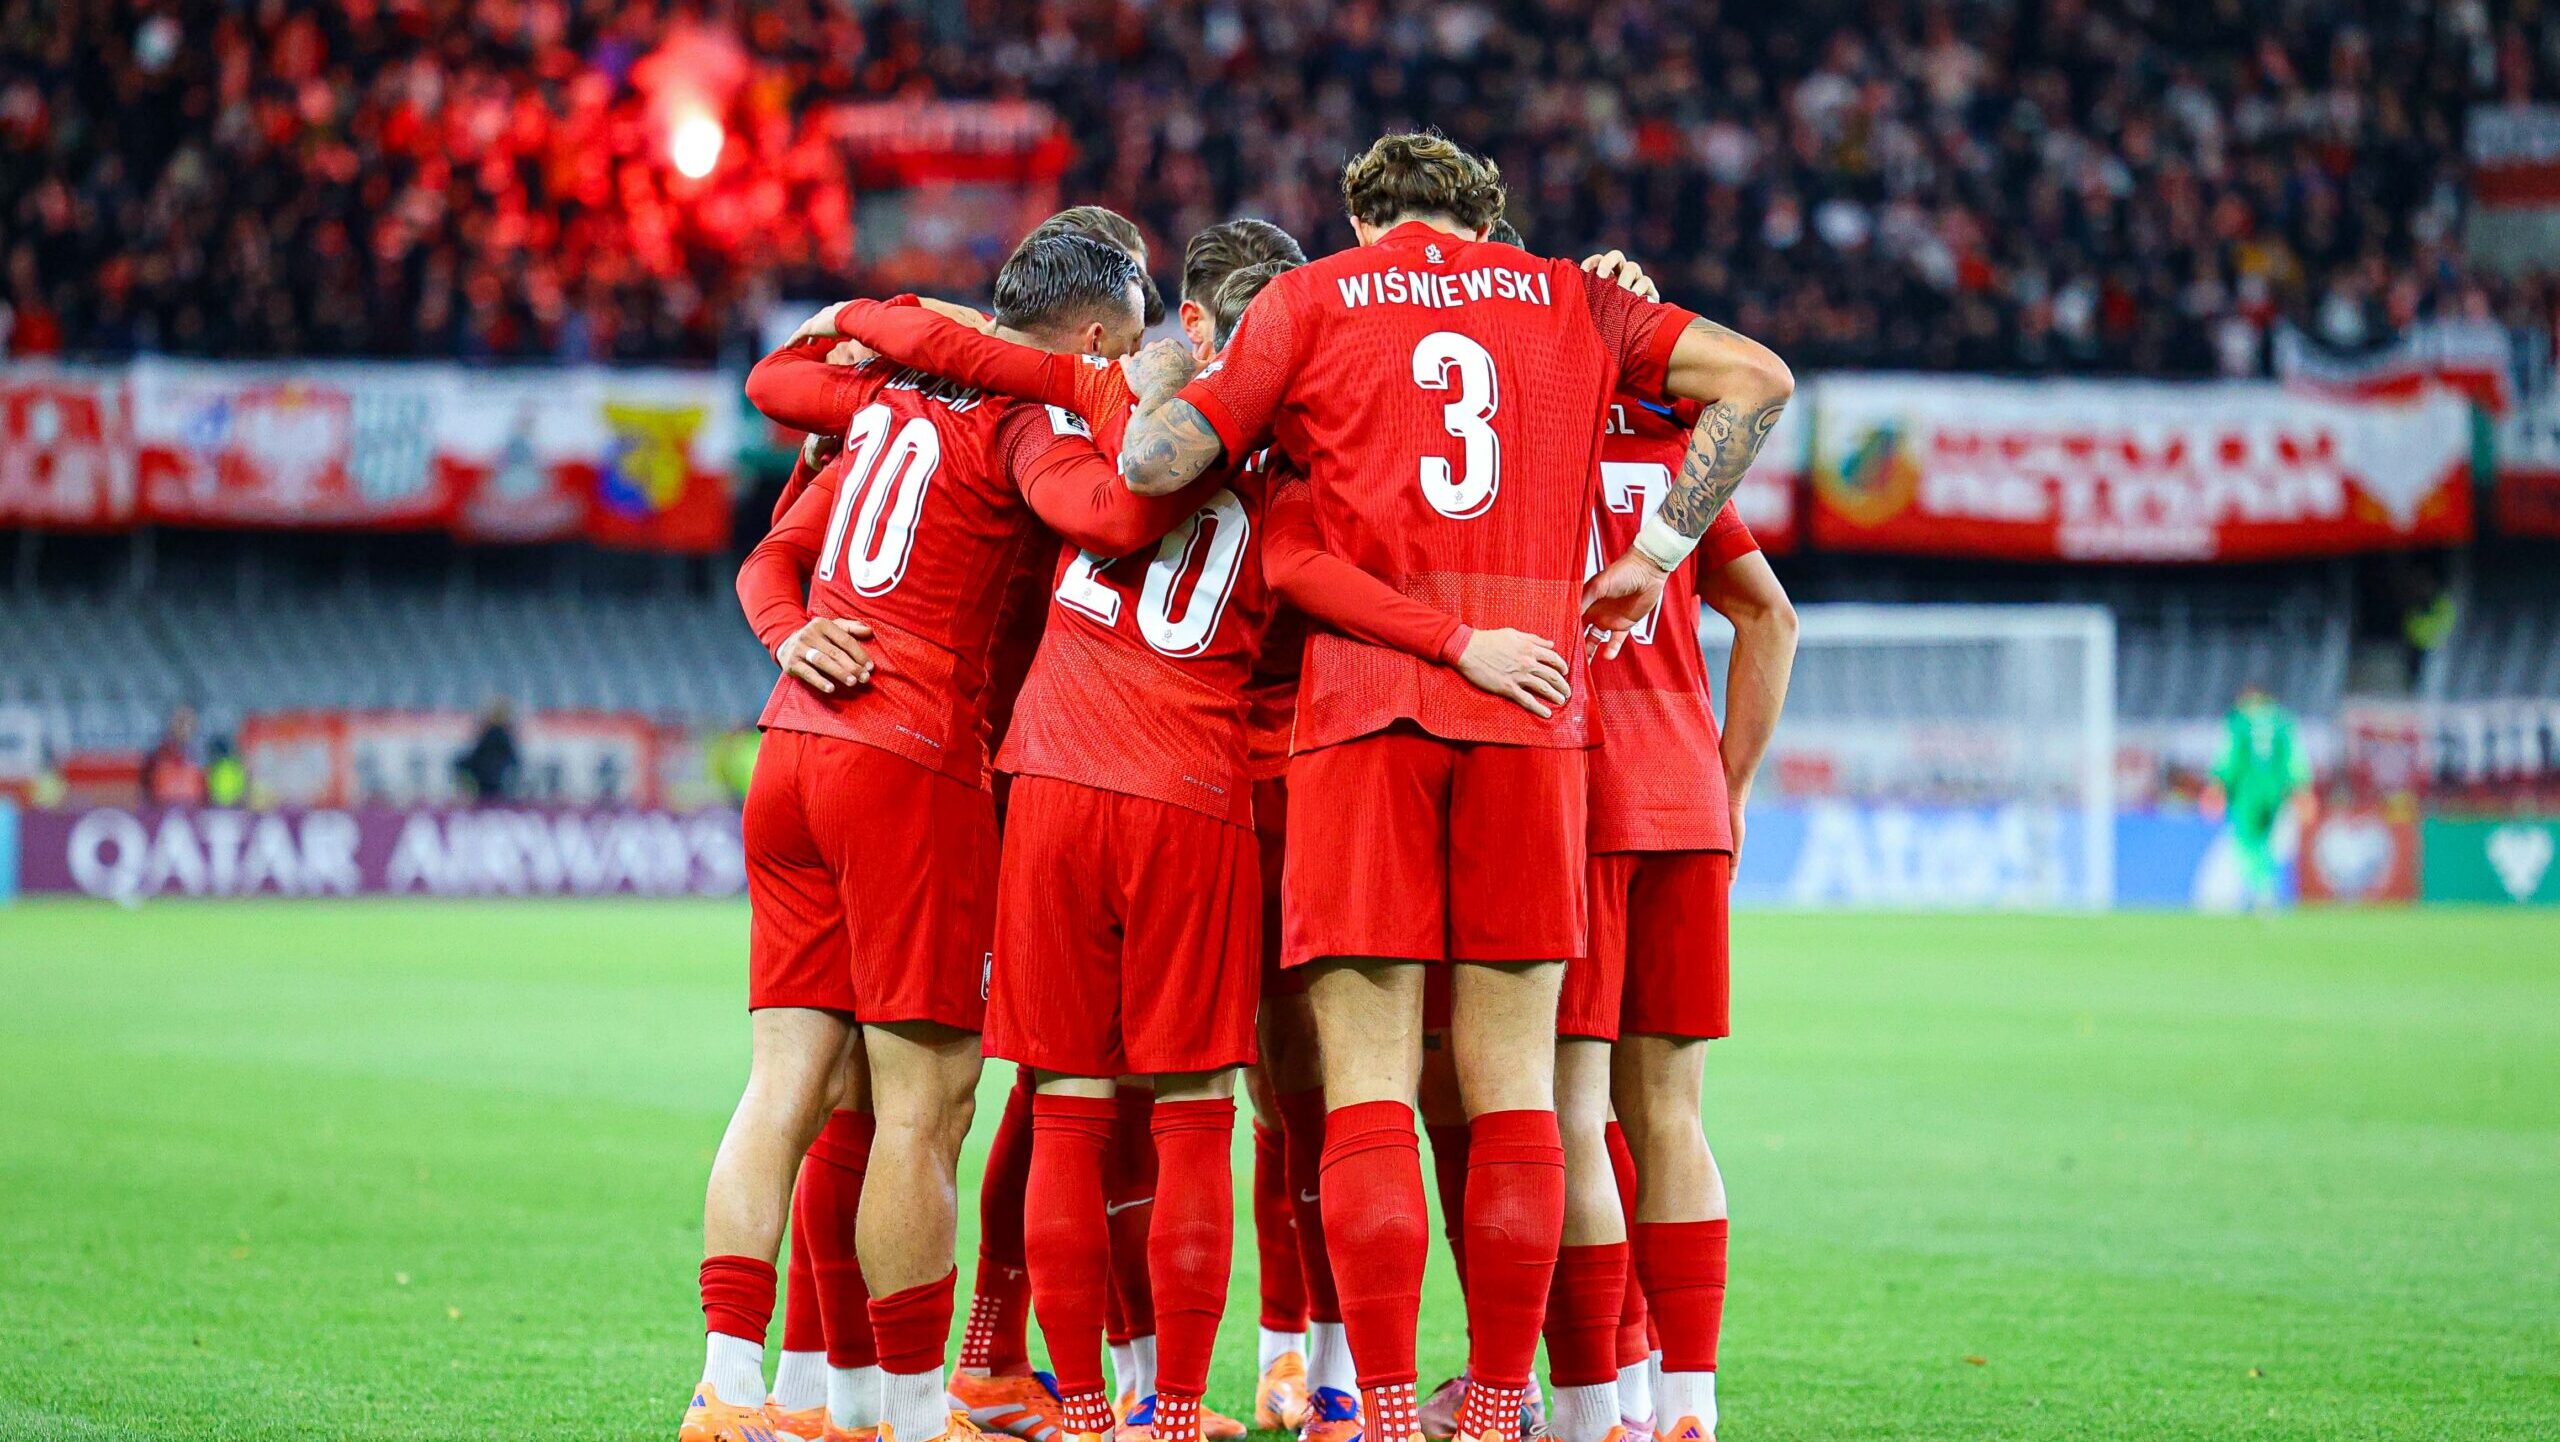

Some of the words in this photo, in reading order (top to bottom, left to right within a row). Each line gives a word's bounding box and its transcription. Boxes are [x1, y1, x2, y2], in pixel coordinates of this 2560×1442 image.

[1336, 266, 1551, 309] WIŚNIEWSKI
[1412, 331, 1500, 520] 3
[818, 402, 941, 598] 10
[67, 806, 362, 909] QATAR
